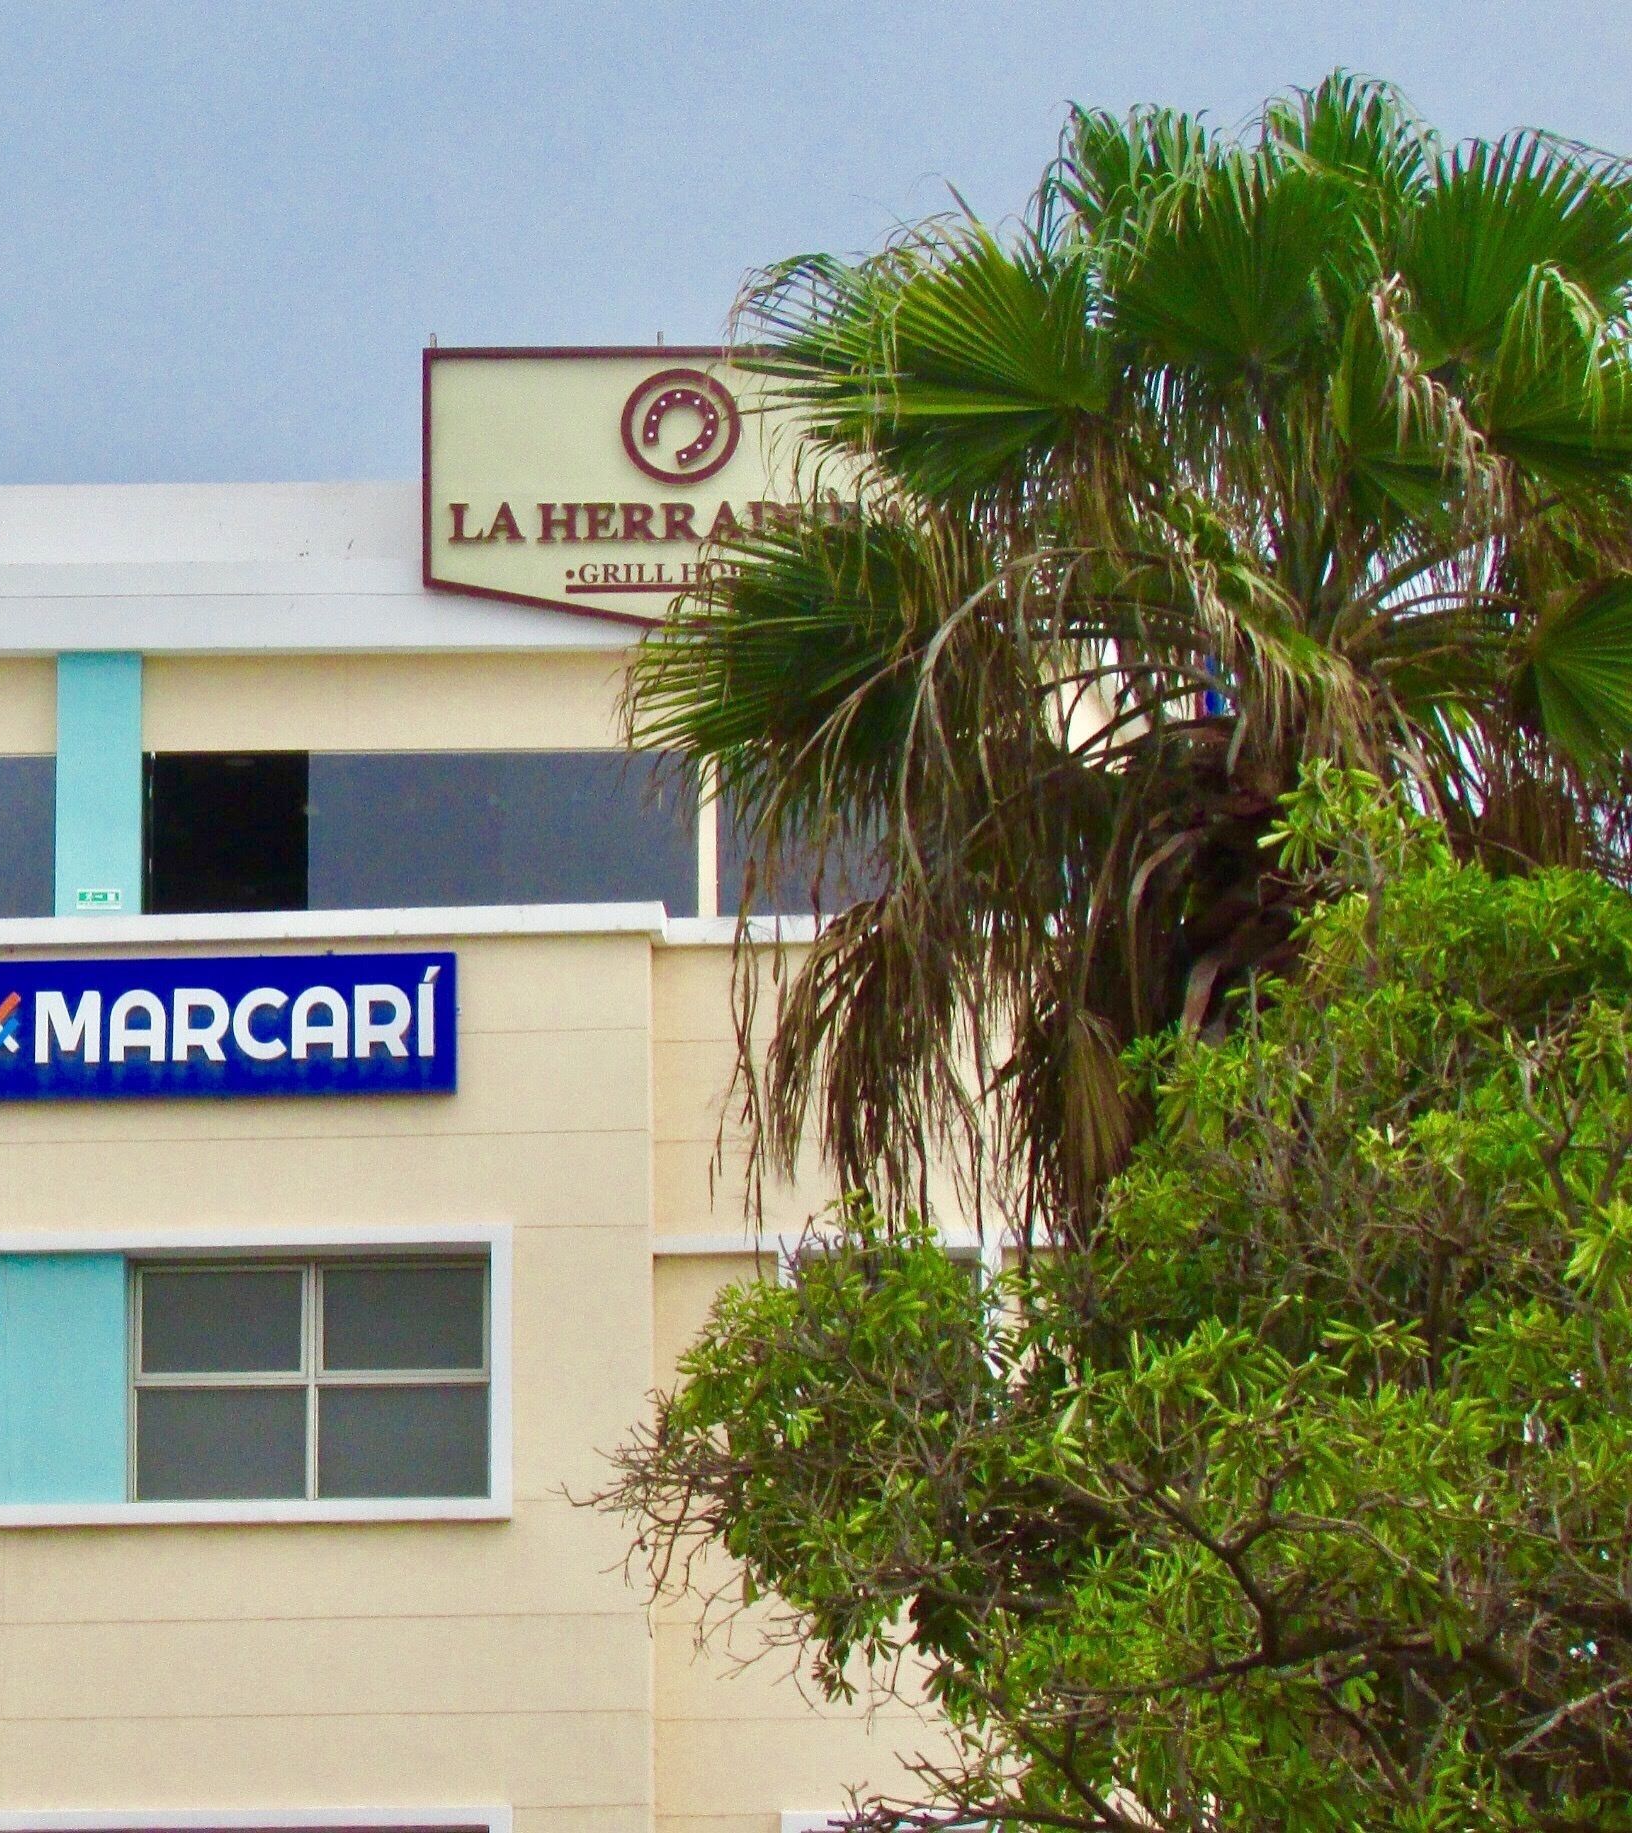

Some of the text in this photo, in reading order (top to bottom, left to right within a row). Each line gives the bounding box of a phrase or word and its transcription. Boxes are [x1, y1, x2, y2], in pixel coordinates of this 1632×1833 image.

[448, 501, 526, 542] LA
[578, 563, 673, 584] GRILL
[34, 965, 441, 1063] MARCARÍ
